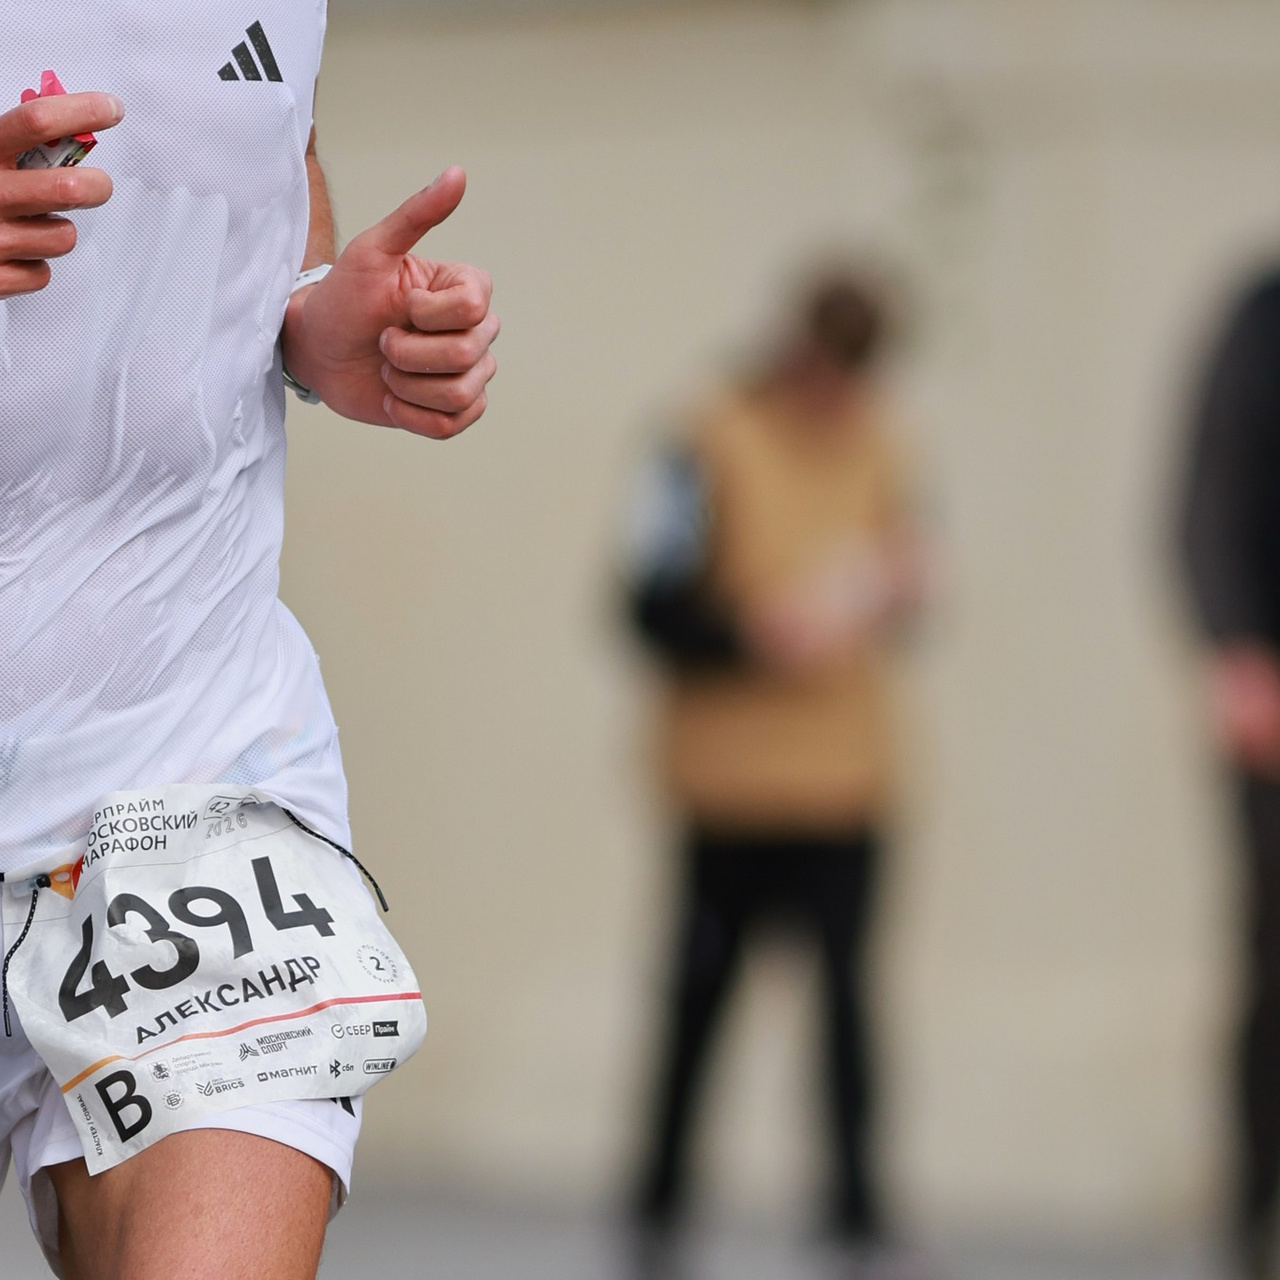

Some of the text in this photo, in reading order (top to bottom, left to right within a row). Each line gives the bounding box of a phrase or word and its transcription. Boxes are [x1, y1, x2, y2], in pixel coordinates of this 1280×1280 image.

[88, 811, 198, 847] ОСКОВСКИЙ
[205, 812, 248, 840] 2026
[58, 856, 335, 1022] 4394
[369, 956, 386, 971] 2
[135, 956, 321, 1045] АЛЕКСАНДР
[256, 1026, 314, 1046] МОСКОВСКИЙ
[346, 1024, 395, 1036] СБЕР Прайм
[260, 1041, 289, 1055] СПОРТ
[365, 1060, 390, 1071] WINLINE
[214, 1080, 245, 1094] BRICS
[76, 1093, 91, 1121] CORRAL
[90, 1126, 104, 1156] КЛАСТЕР
